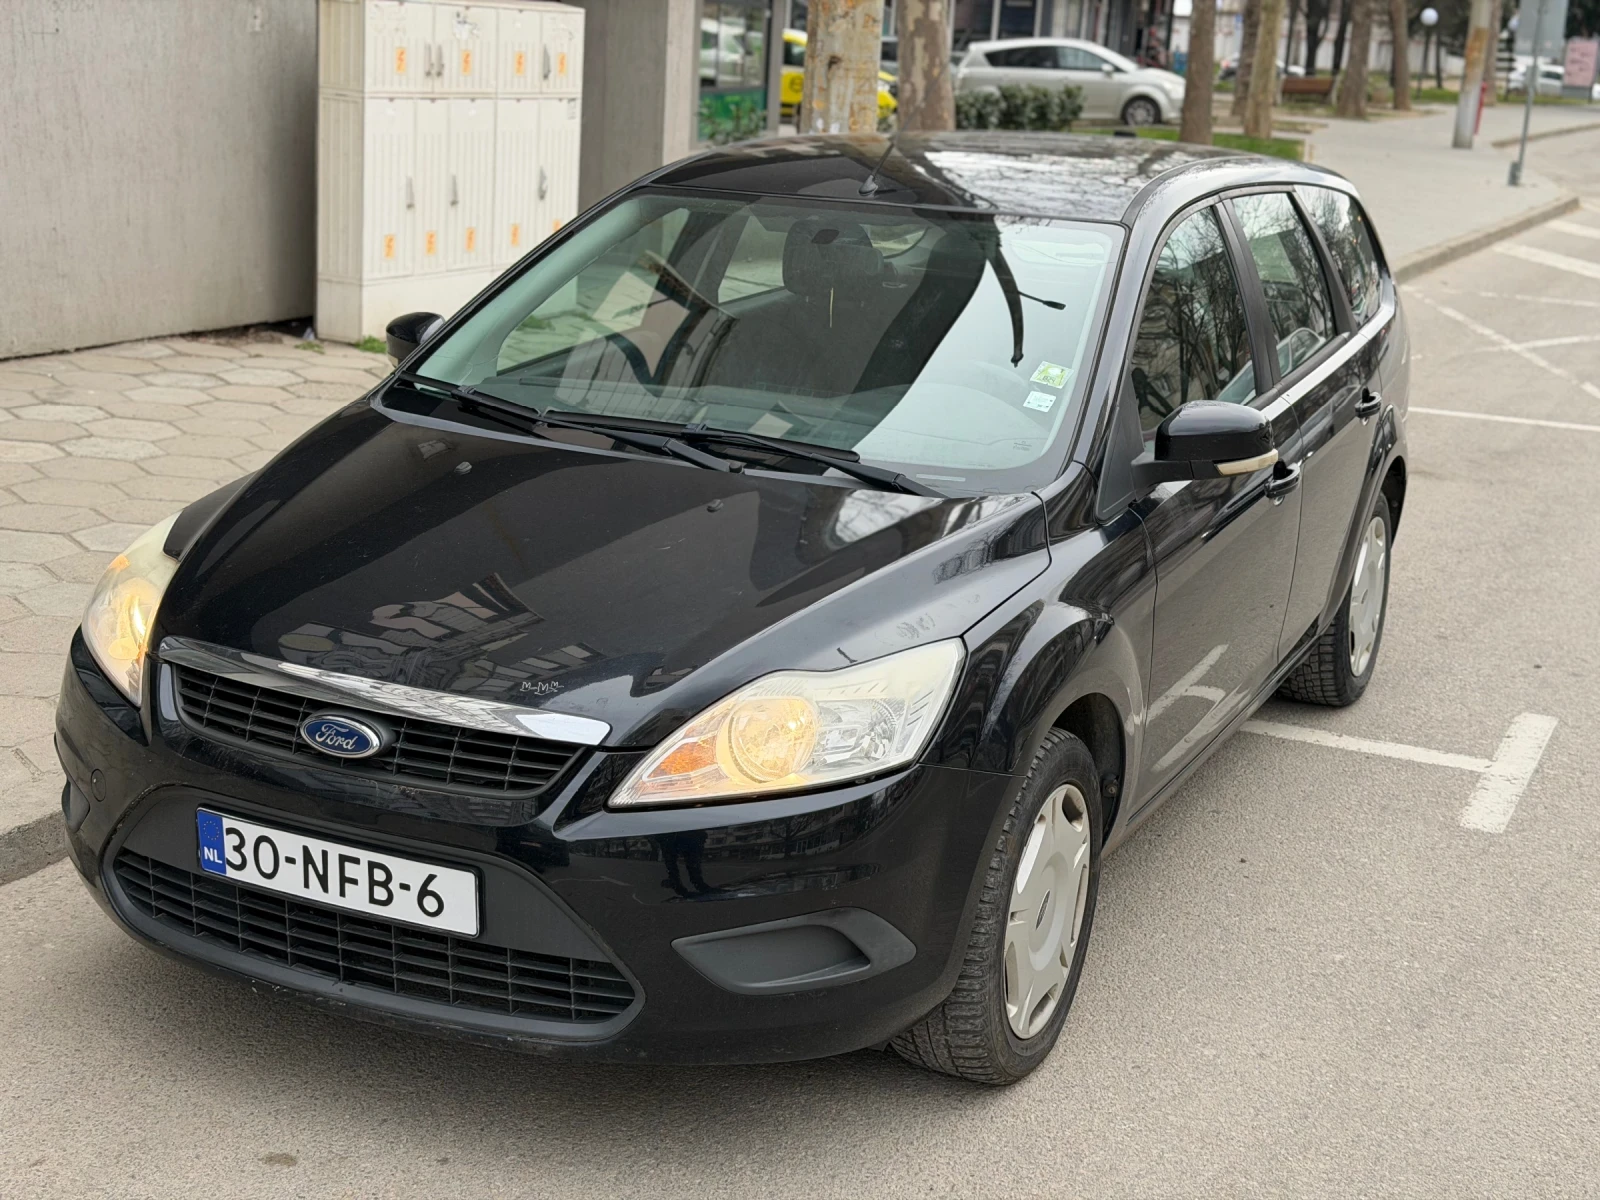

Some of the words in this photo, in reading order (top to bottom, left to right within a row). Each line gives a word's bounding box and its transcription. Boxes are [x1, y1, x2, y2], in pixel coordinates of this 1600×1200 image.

[316, 724, 357, 750] Ford
[204, 846, 222, 864] NL
[226, 827, 444, 918] 30-NFB-6
